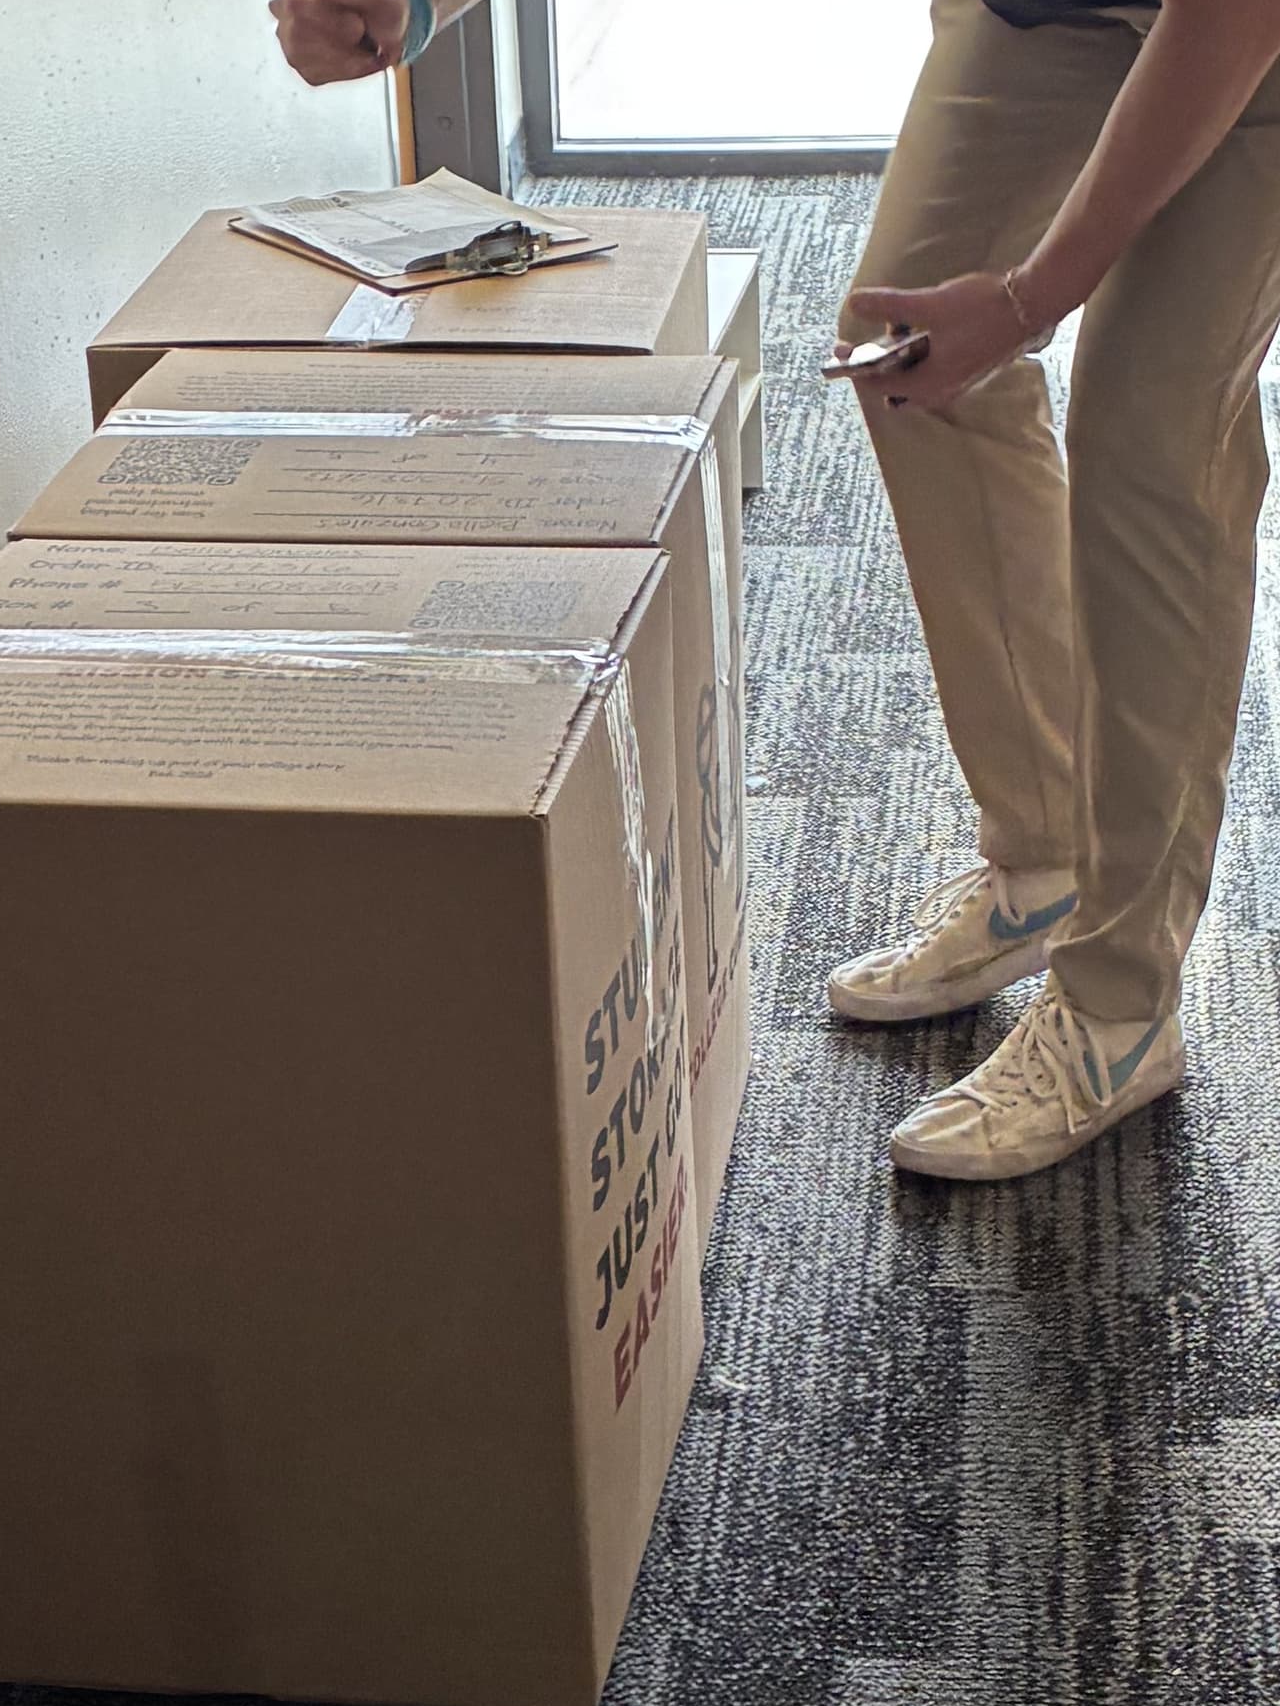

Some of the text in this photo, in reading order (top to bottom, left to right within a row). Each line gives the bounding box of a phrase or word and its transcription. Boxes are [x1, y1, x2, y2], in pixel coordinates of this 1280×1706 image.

[4, 577, 94, 589] Phone
[25, 558, 114, 570] Order
[584, 801, 677, 1096] STUENT
[595, 1131, 660, 1331] JUST
[615, 1154, 689, 1415] EASIER.
